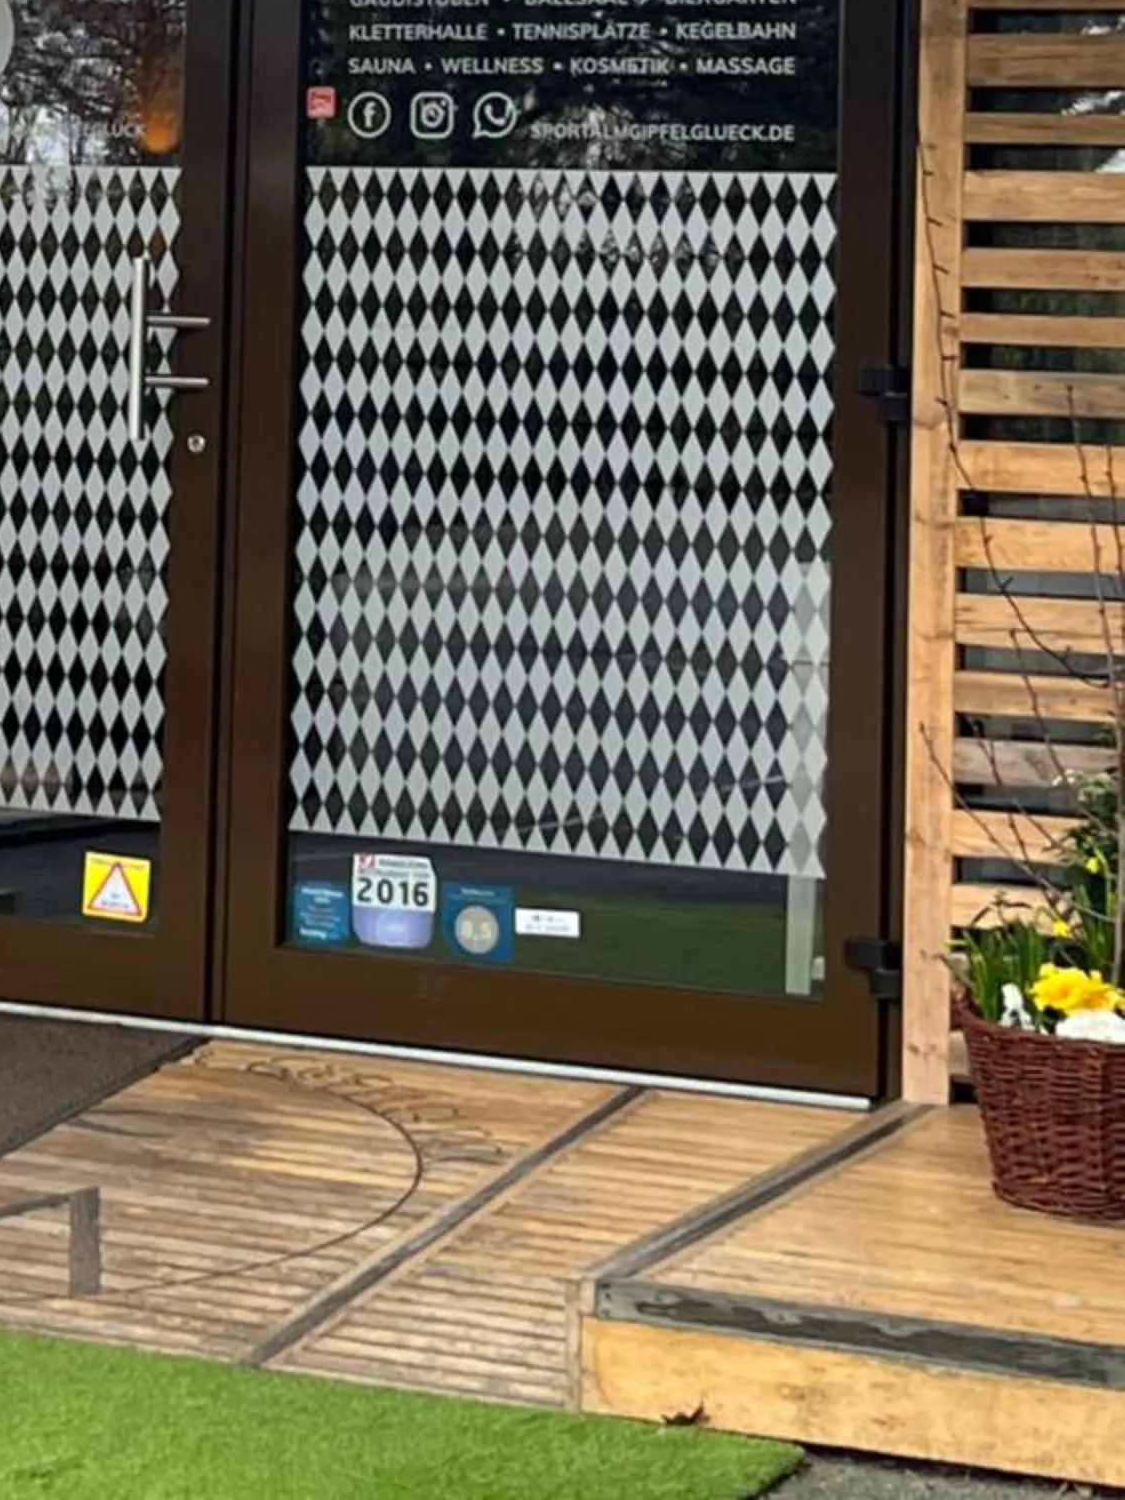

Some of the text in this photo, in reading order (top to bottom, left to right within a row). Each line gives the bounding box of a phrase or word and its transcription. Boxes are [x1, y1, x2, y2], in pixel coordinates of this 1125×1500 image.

[349, 19, 796, 41] KLETTERHALLE TENNISPLÄTZE KEGELBAHN
[348, 57, 796, 75] SAUNA WELLNESS KOSMETIK MASSAGE
[357, 876, 428, 907] 2016
